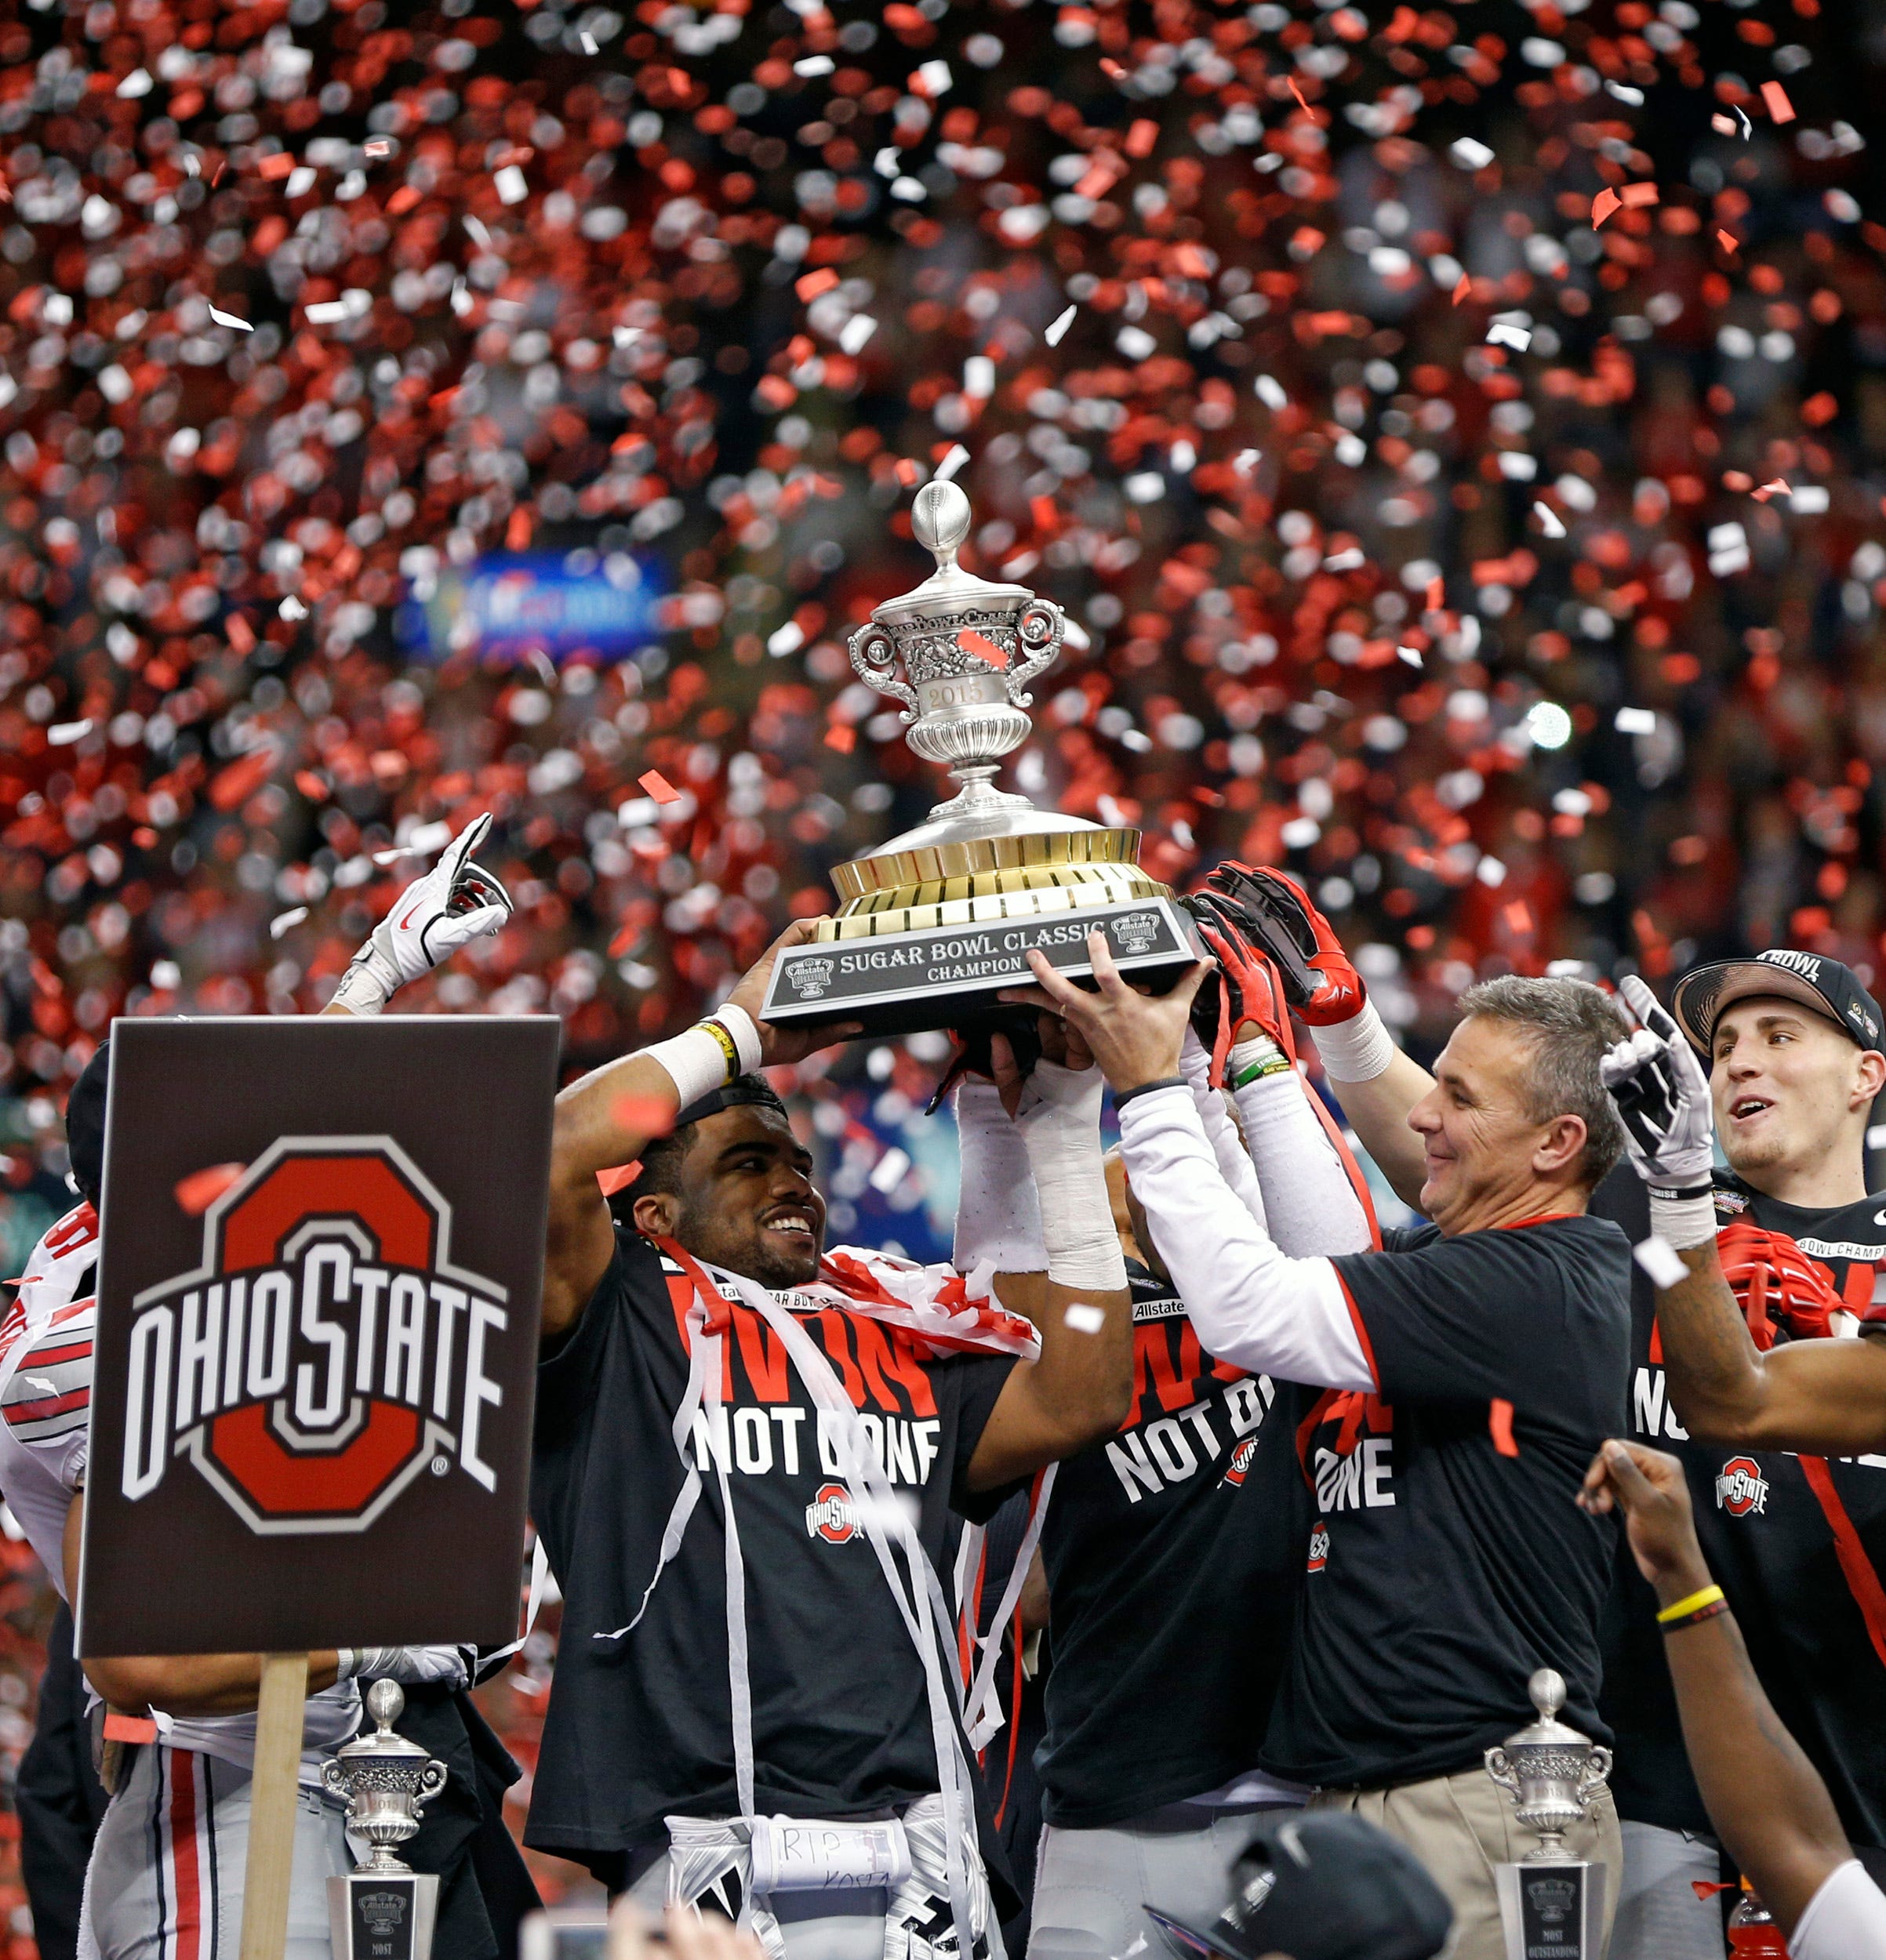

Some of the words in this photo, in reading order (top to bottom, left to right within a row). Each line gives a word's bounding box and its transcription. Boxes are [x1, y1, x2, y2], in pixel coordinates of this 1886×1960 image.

[929, 683, 983, 707] 2015
[1120, 920, 1151, 931] Allstate
[840, 946, 925, 974] SUGAR
[931, 934, 999, 961] BOWL
[1004, 921, 1106, 951] CLASSIC
[794, 965, 825, 976] Allstate
[928, 956, 1022, 982] CHAMPION
[1800, 1240, 1832, 1255] BOWL
[1135, 1301, 1184, 1318] Allstate
[692, 1406, 806, 1475] NOT
[1105, 1399, 1221, 1504] NOT
[783, 1828, 840, 1864] RIP
[372, 1944, 392, 1955] MOST
